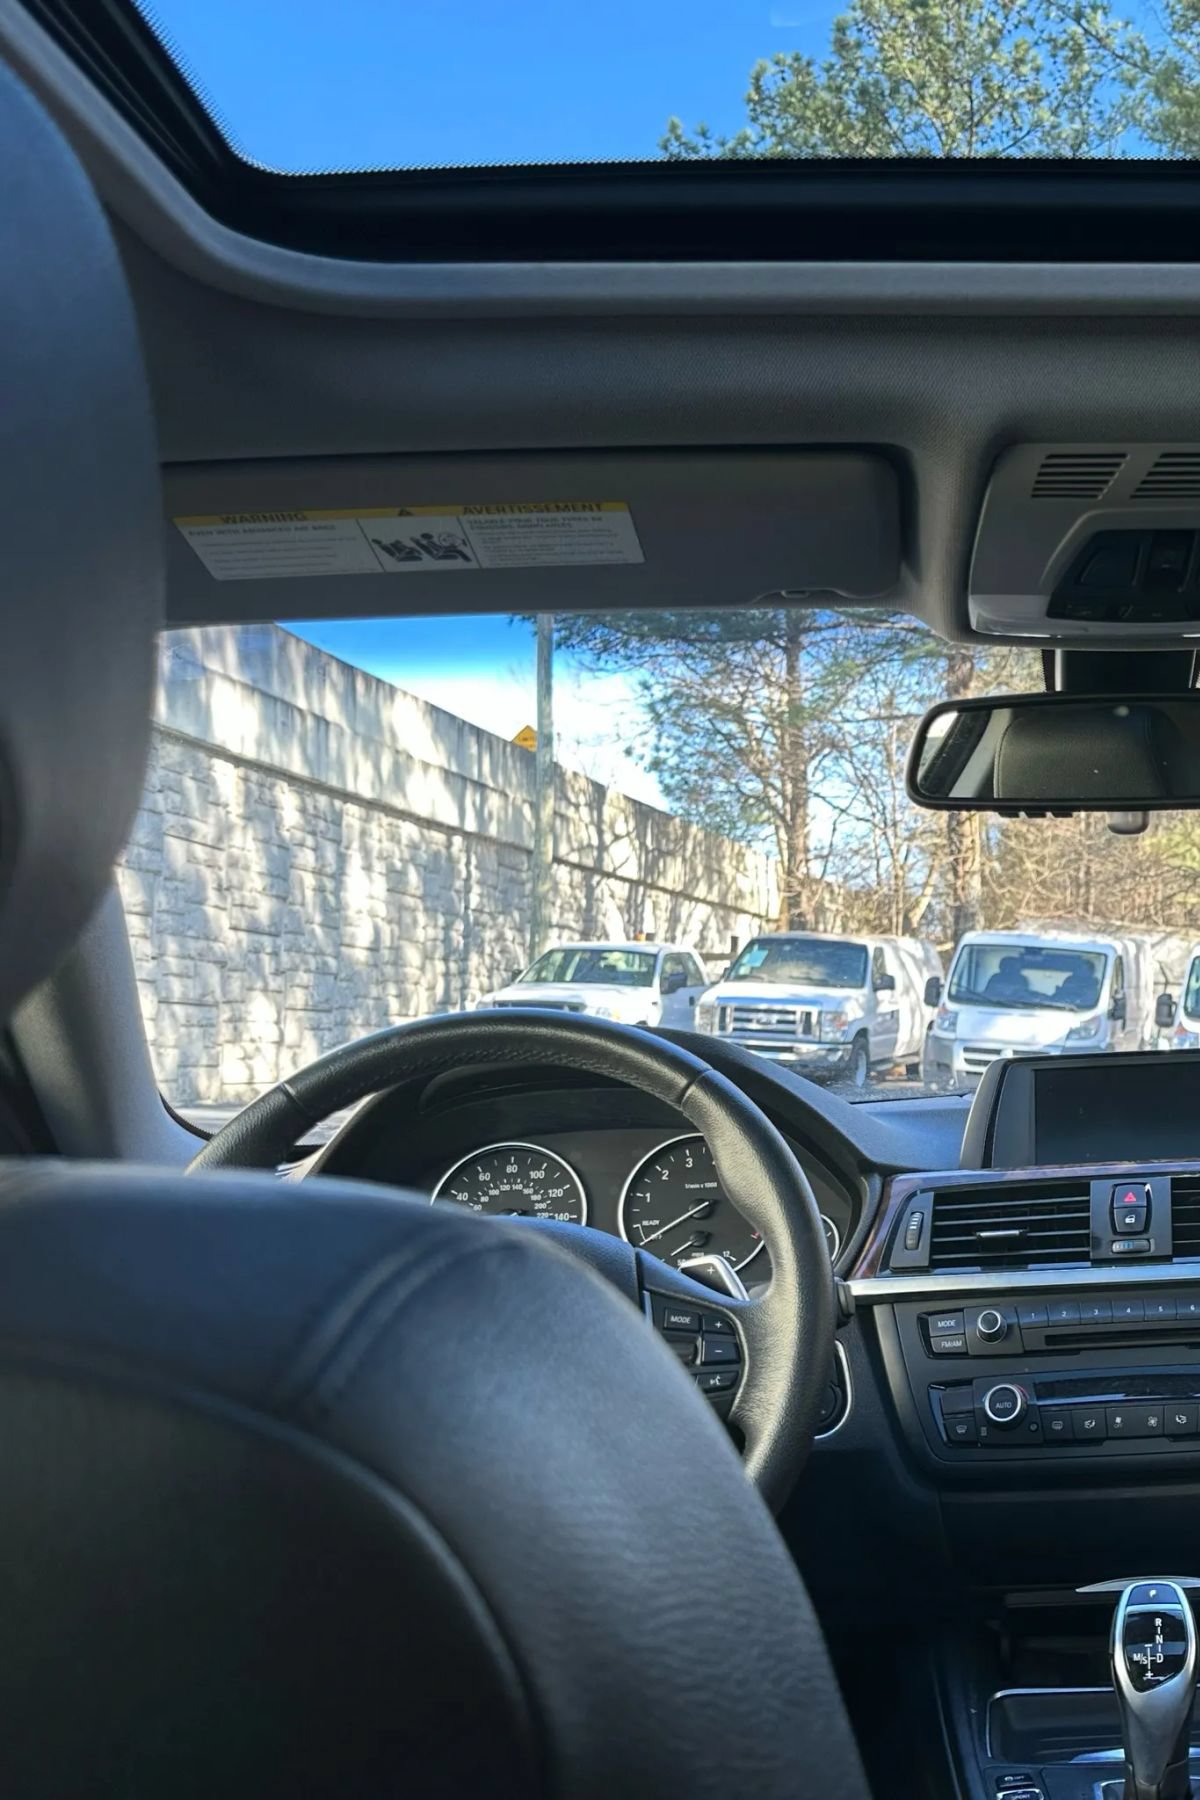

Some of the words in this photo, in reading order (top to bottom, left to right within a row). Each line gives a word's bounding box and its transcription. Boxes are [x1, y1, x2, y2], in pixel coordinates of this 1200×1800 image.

[463, 502, 603, 515] AVERTISSEMENT
[221, 511, 307, 525] WARNING
[685, 1158, 693, 1168] 3
[506, 1164, 518, 1174] 80
[479, 1172, 491, 1181] 60
[529, 1170, 545, 1179] 100
[661, 1170, 669, 1180] 2
[456, 1192, 468, 1201] 40
[548, 1188, 563, 1197] 120
[645, 1192, 651, 1203] 1
[554, 1212, 570, 1221] 140
[670, 1315, 692, 1324] MODE
[938, 1319, 956, 1327] MODE
[995, 1401, 1012, 1409] AUTO
[1149, 1589, 1156, 1597] P
[1155, 1618, 1162, 1627] R
[1156, 1634, 1163, 1644] N
[1133, 1653, 1148, 1665] M/S
[1156, 1653, 1164, 1663] D
